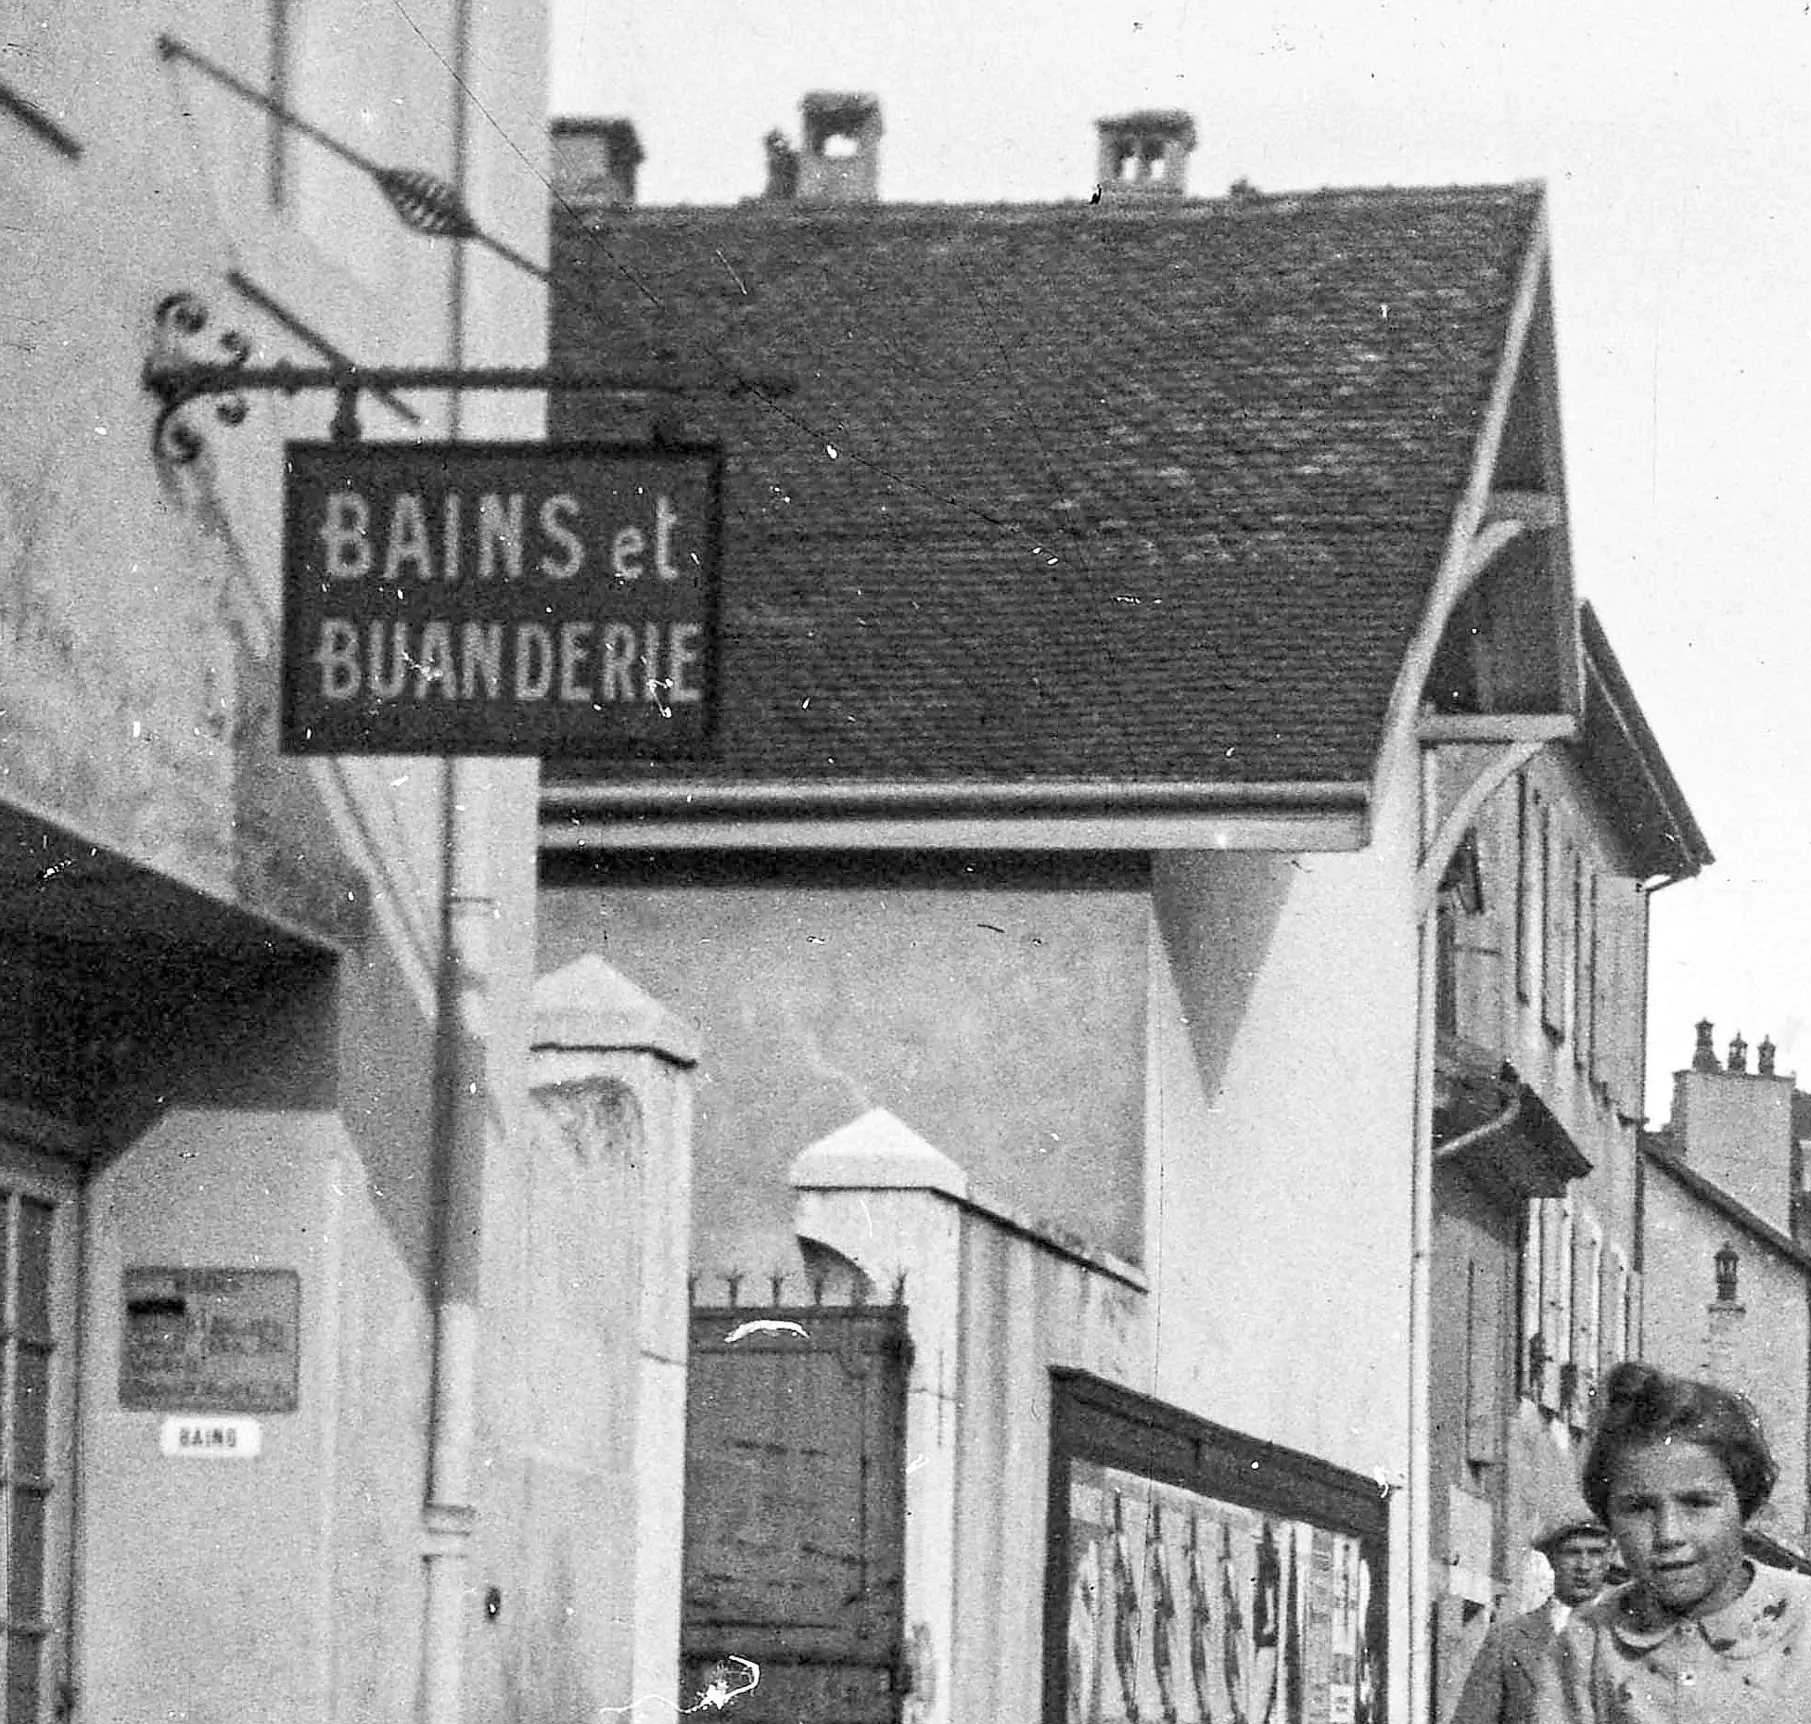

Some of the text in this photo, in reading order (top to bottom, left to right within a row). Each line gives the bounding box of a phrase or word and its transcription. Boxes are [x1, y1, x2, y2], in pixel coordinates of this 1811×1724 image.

[320, 492, 679, 581] BAINS et
[316, 618, 704, 703] BUANDERIE
[179, 1428, 237, 1448] BAINS
